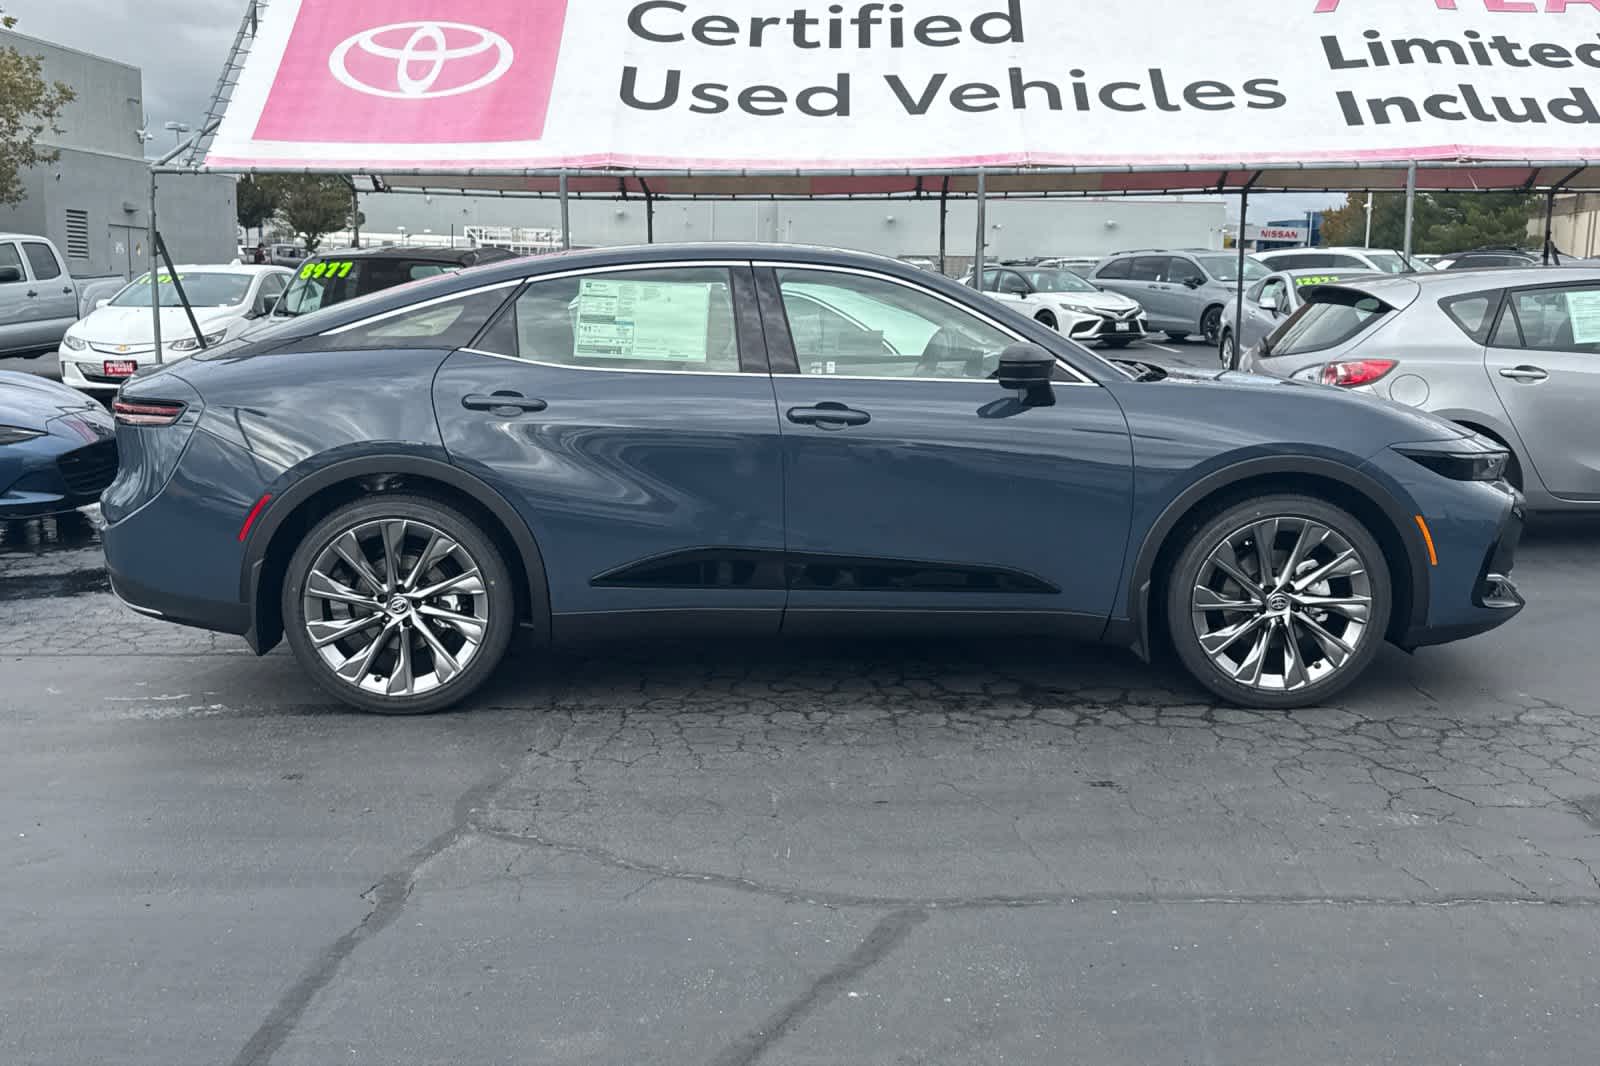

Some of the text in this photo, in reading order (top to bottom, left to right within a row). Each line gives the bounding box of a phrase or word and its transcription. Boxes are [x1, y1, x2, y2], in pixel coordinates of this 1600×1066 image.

[628, 0, 1024, 48] Certified
[620, 66, 1286, 116] Used Vehicles
[1336, 84, 1600, 126] Includ
[1261, 230, 1298, 239] NISSAN
[299, 261, 353, 281] 8977
